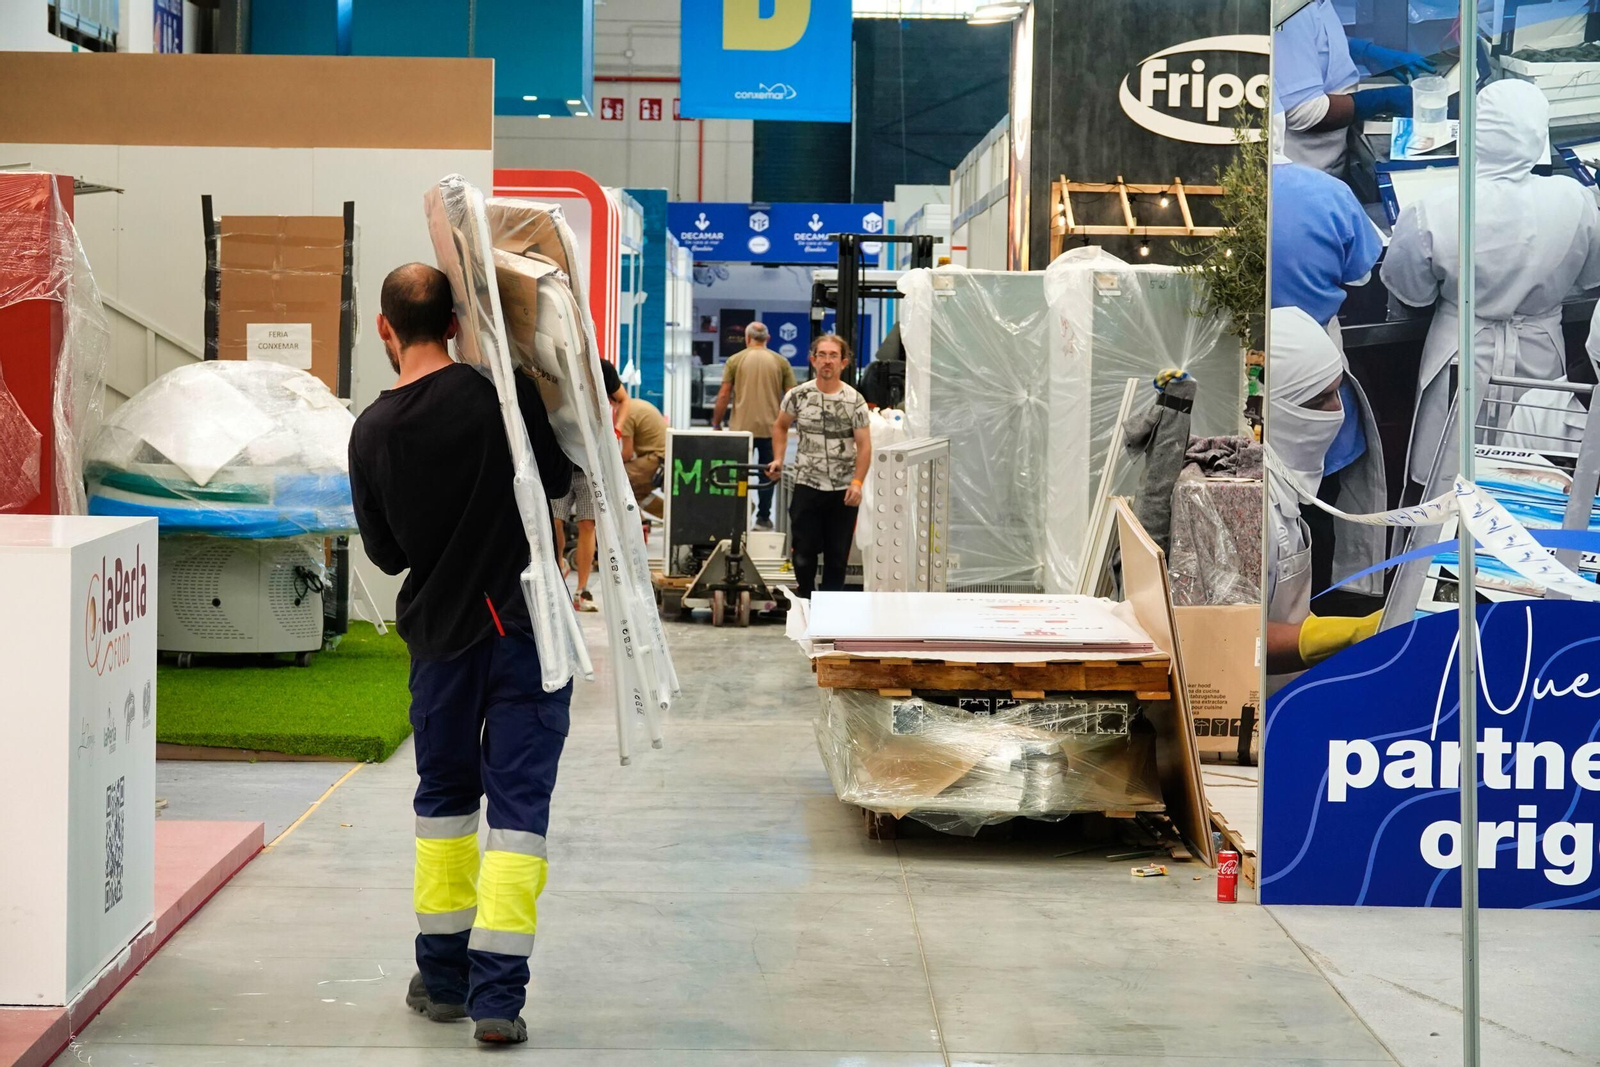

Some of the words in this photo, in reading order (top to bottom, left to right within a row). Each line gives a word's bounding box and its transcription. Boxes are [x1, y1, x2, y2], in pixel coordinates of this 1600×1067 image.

[734, 91, 785, 100] conxemar
[680, 232, 724, 240] DECAMAR
[257, 342, 299, 350] CONXEMAR
[1474, 446, 1535, 459] ajamar
[102, 542, 147, 636] laPerla
[114, 631, 131, 670] FOOD
[1419, 804, 1600, 886] orig
